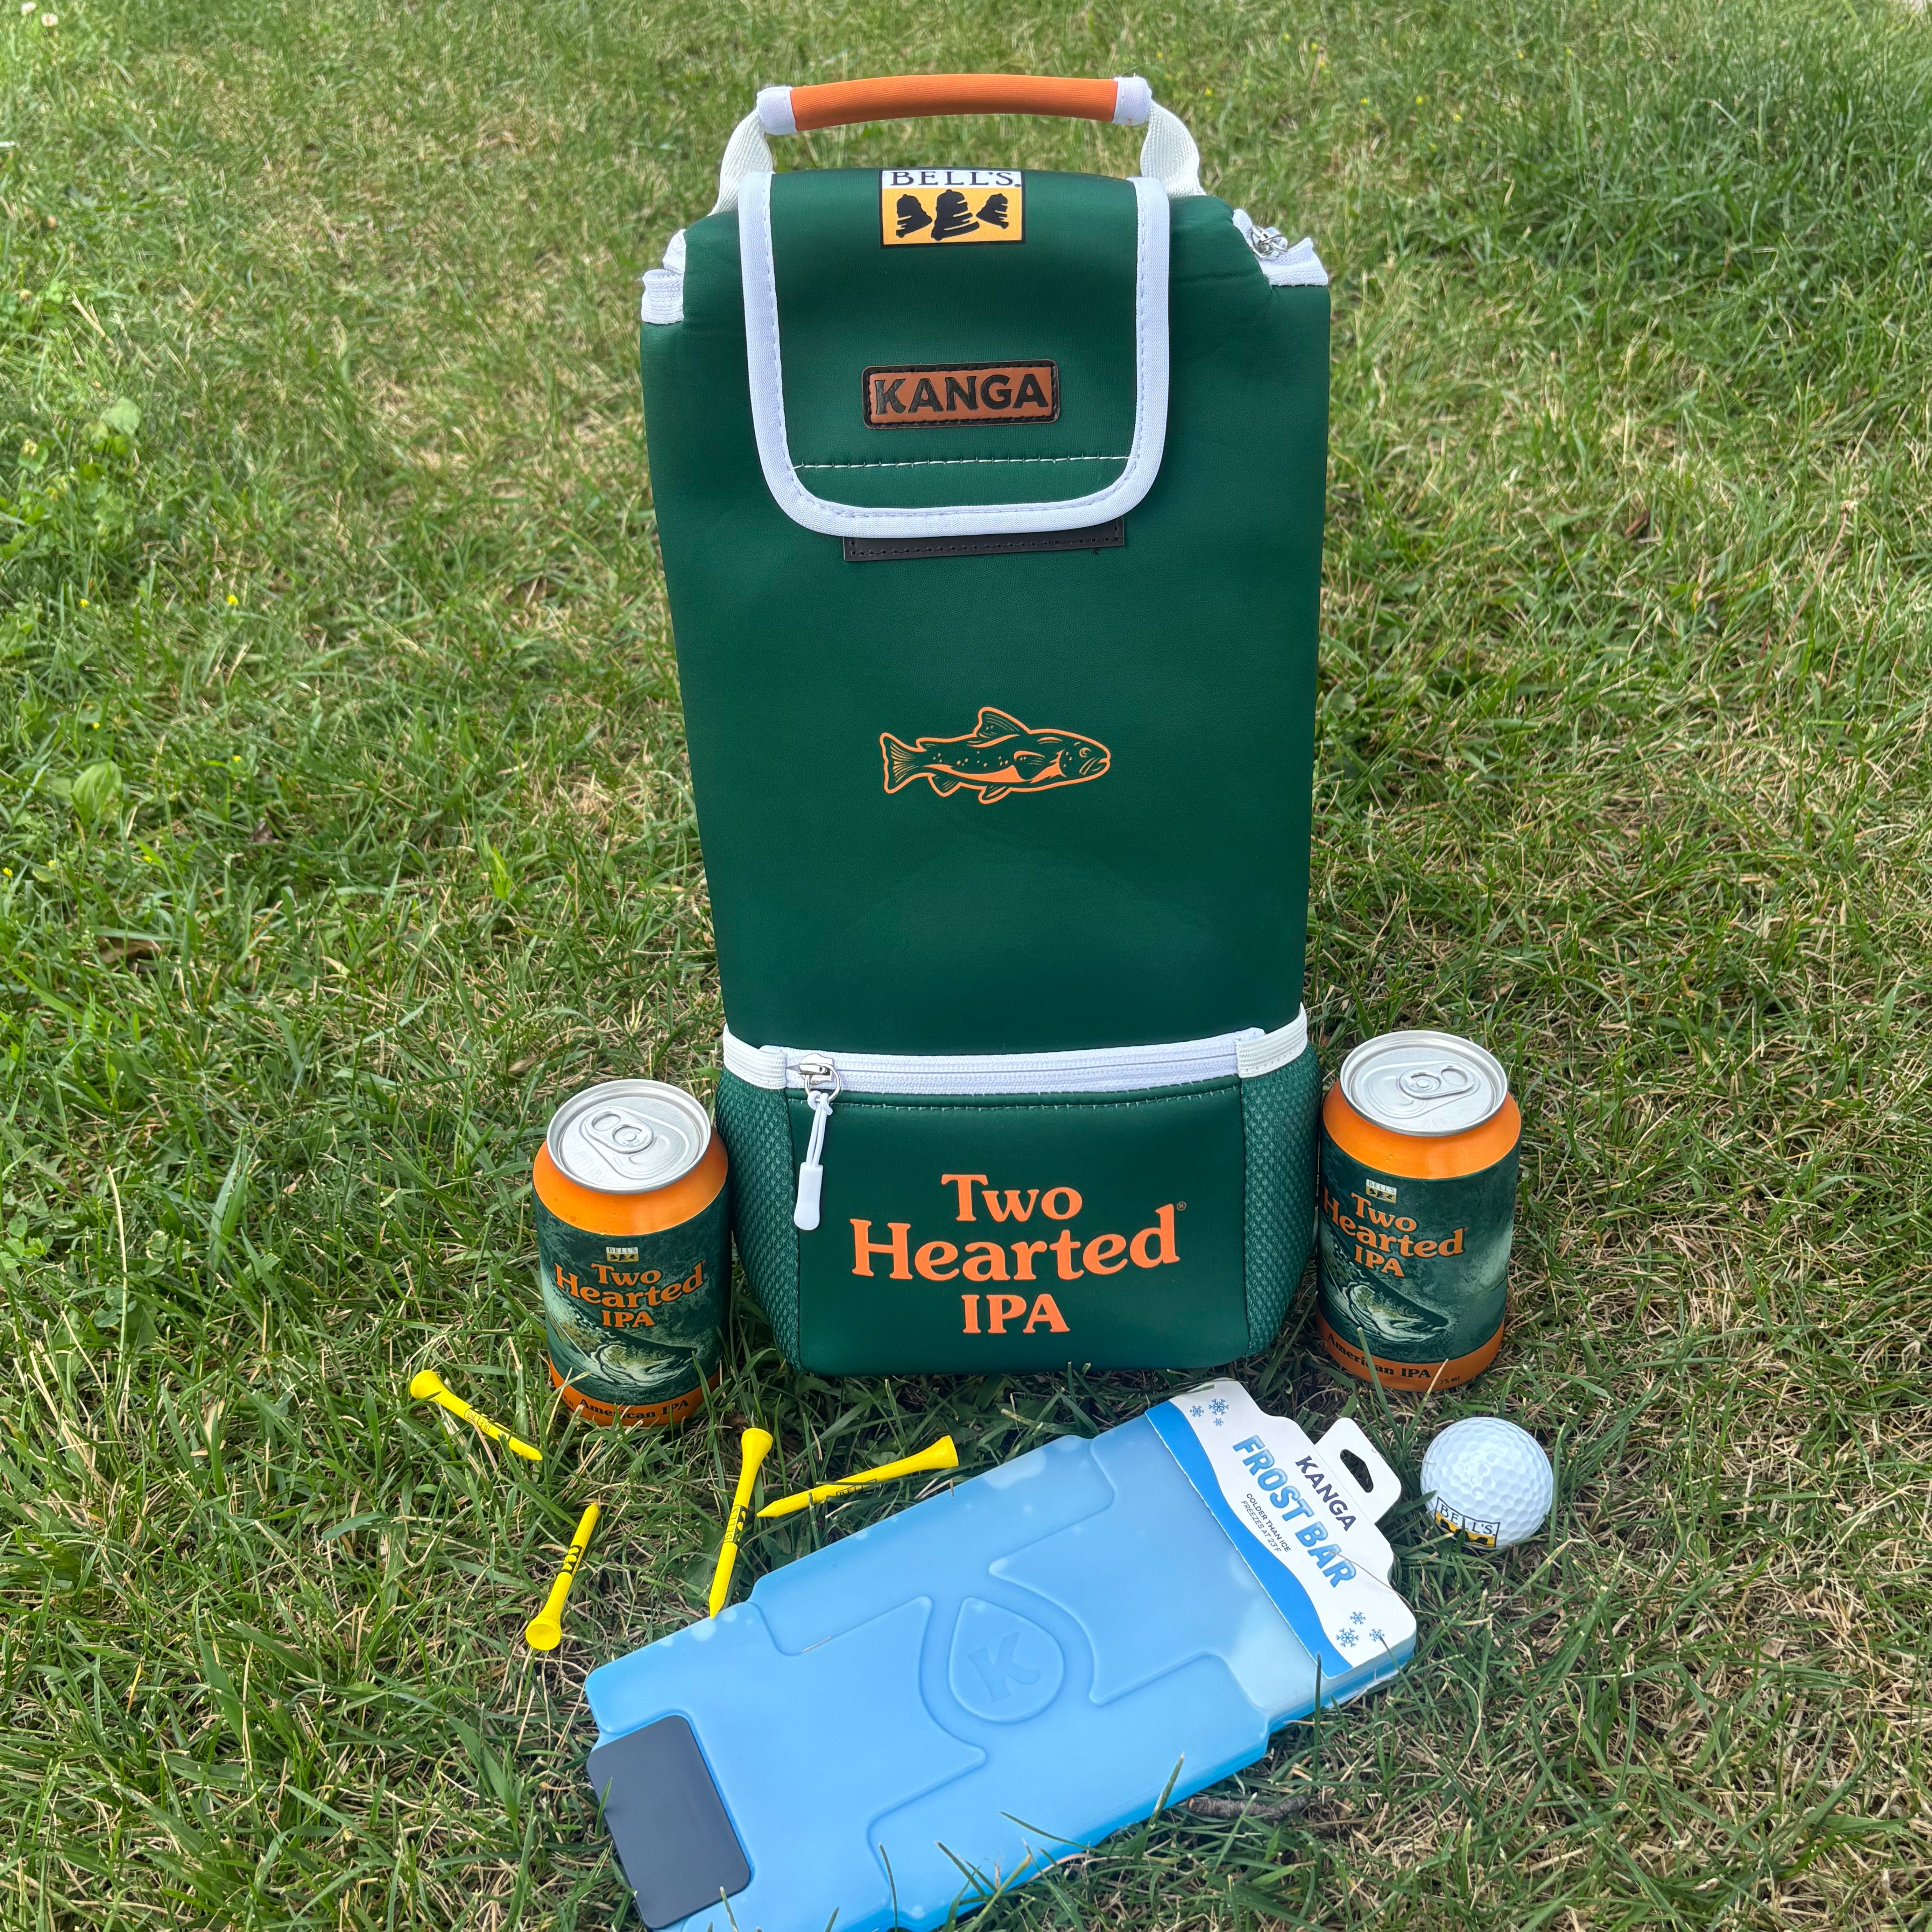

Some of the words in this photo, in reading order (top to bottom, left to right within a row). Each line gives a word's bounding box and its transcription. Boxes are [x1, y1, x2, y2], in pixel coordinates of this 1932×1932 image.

[874, 374, 1049, 414] KANGA
[941, 1174, 1082, 1222] Two
[1351, 1193, 1417, 1232] Two
[1323, 1186, 1465, 1257] Hearted
[591, 1263, 662, 1286] Two
[1354, 1244, 1405, 1277] IPA
[555, 1262, 704, 1308] Hearted
[601, 1310, 655, 1328] IPA
[961, 1294, 1070, 1334] IPA
[1328, 1333, 1394, 1375] Amerian
[1401, 1368, 1431, 1378] IPA
[580, 1399, 656, 1419] Amecan
[662, 1400, 690, 1415] IPA
[1232, 1435, 1314, 1522] FROST
[1295, 1521, 1357, 1588] BAR
[1295, 1455, 1357, 1532] KANGA
[1241, 1500, 1265, 1529] FREEZES
[1246, 1493, 1268, 1520] COLDER
[1265, 1519, 1282, 1540] THAN
[1279, 1540, 1291, 1552] ICE
[1440, 1504, 1493, 1534] BEL'S
